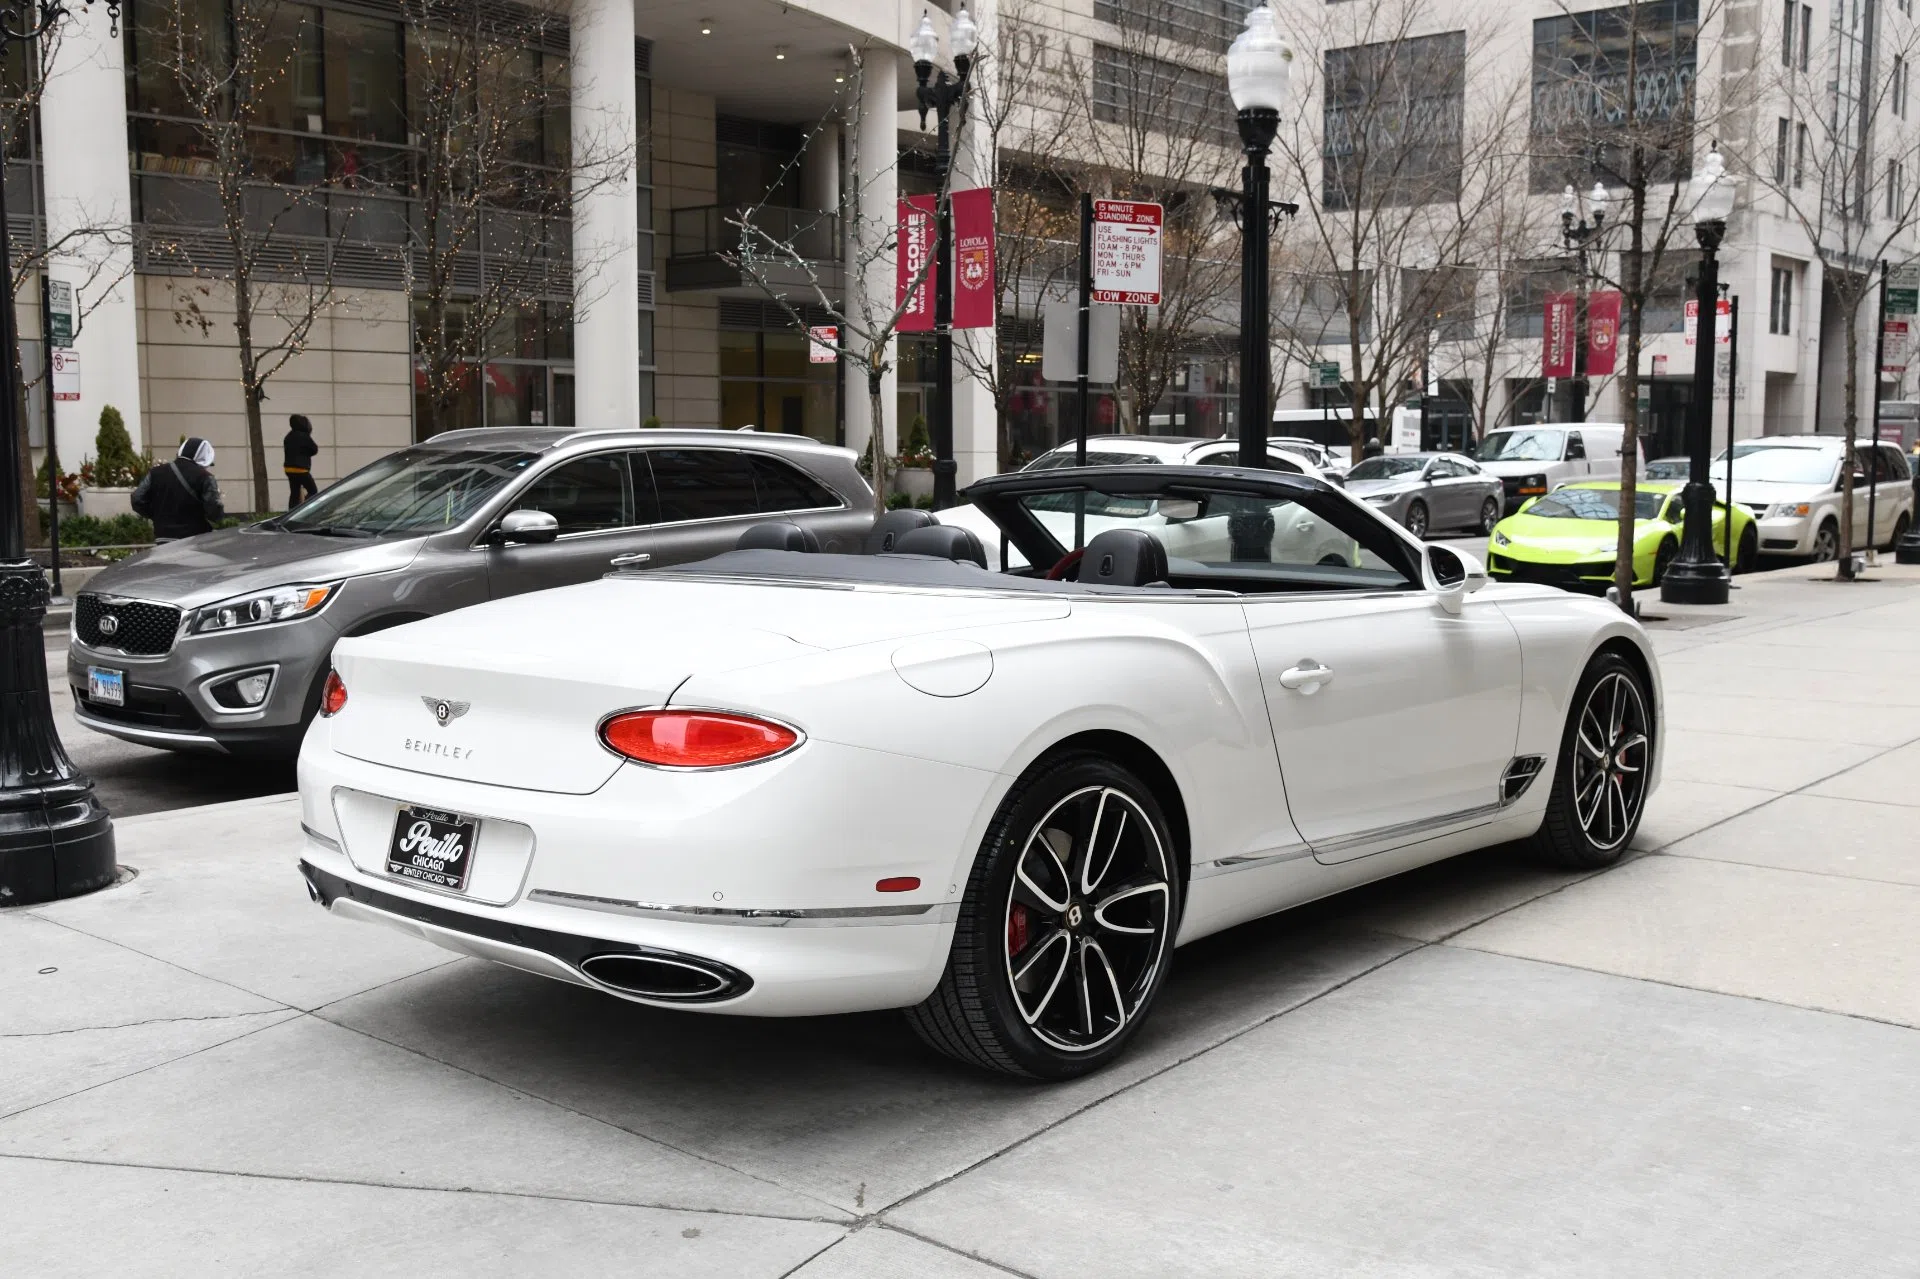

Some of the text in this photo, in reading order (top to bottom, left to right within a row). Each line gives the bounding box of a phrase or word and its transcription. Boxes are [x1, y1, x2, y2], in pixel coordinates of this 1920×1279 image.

[1098, 203, 1134, 213] 15 MINUTE
[1098, 211, 1155, 223] STANDING ZONE
[960, 237, 988, 247] LOYOLA
[1097, 234, 1158, 246] FLASHING LIGHTS
[1125, 244, 1130, 252] 8
[1097, 252, 1114, 260] MON
[1122, 253, 1146, 261] THURS
[1116, 270, 1131, 278] SUN
[1096, 290, 1154, 303] TOW ZONE
[404, 738, 473, 760] BENTLEY
[399, 820, 464, 863] Perillo
[412, 854, 445, 871] CHICAGO
[402, 866, 445, 884] BENTLEY CHICAGO
